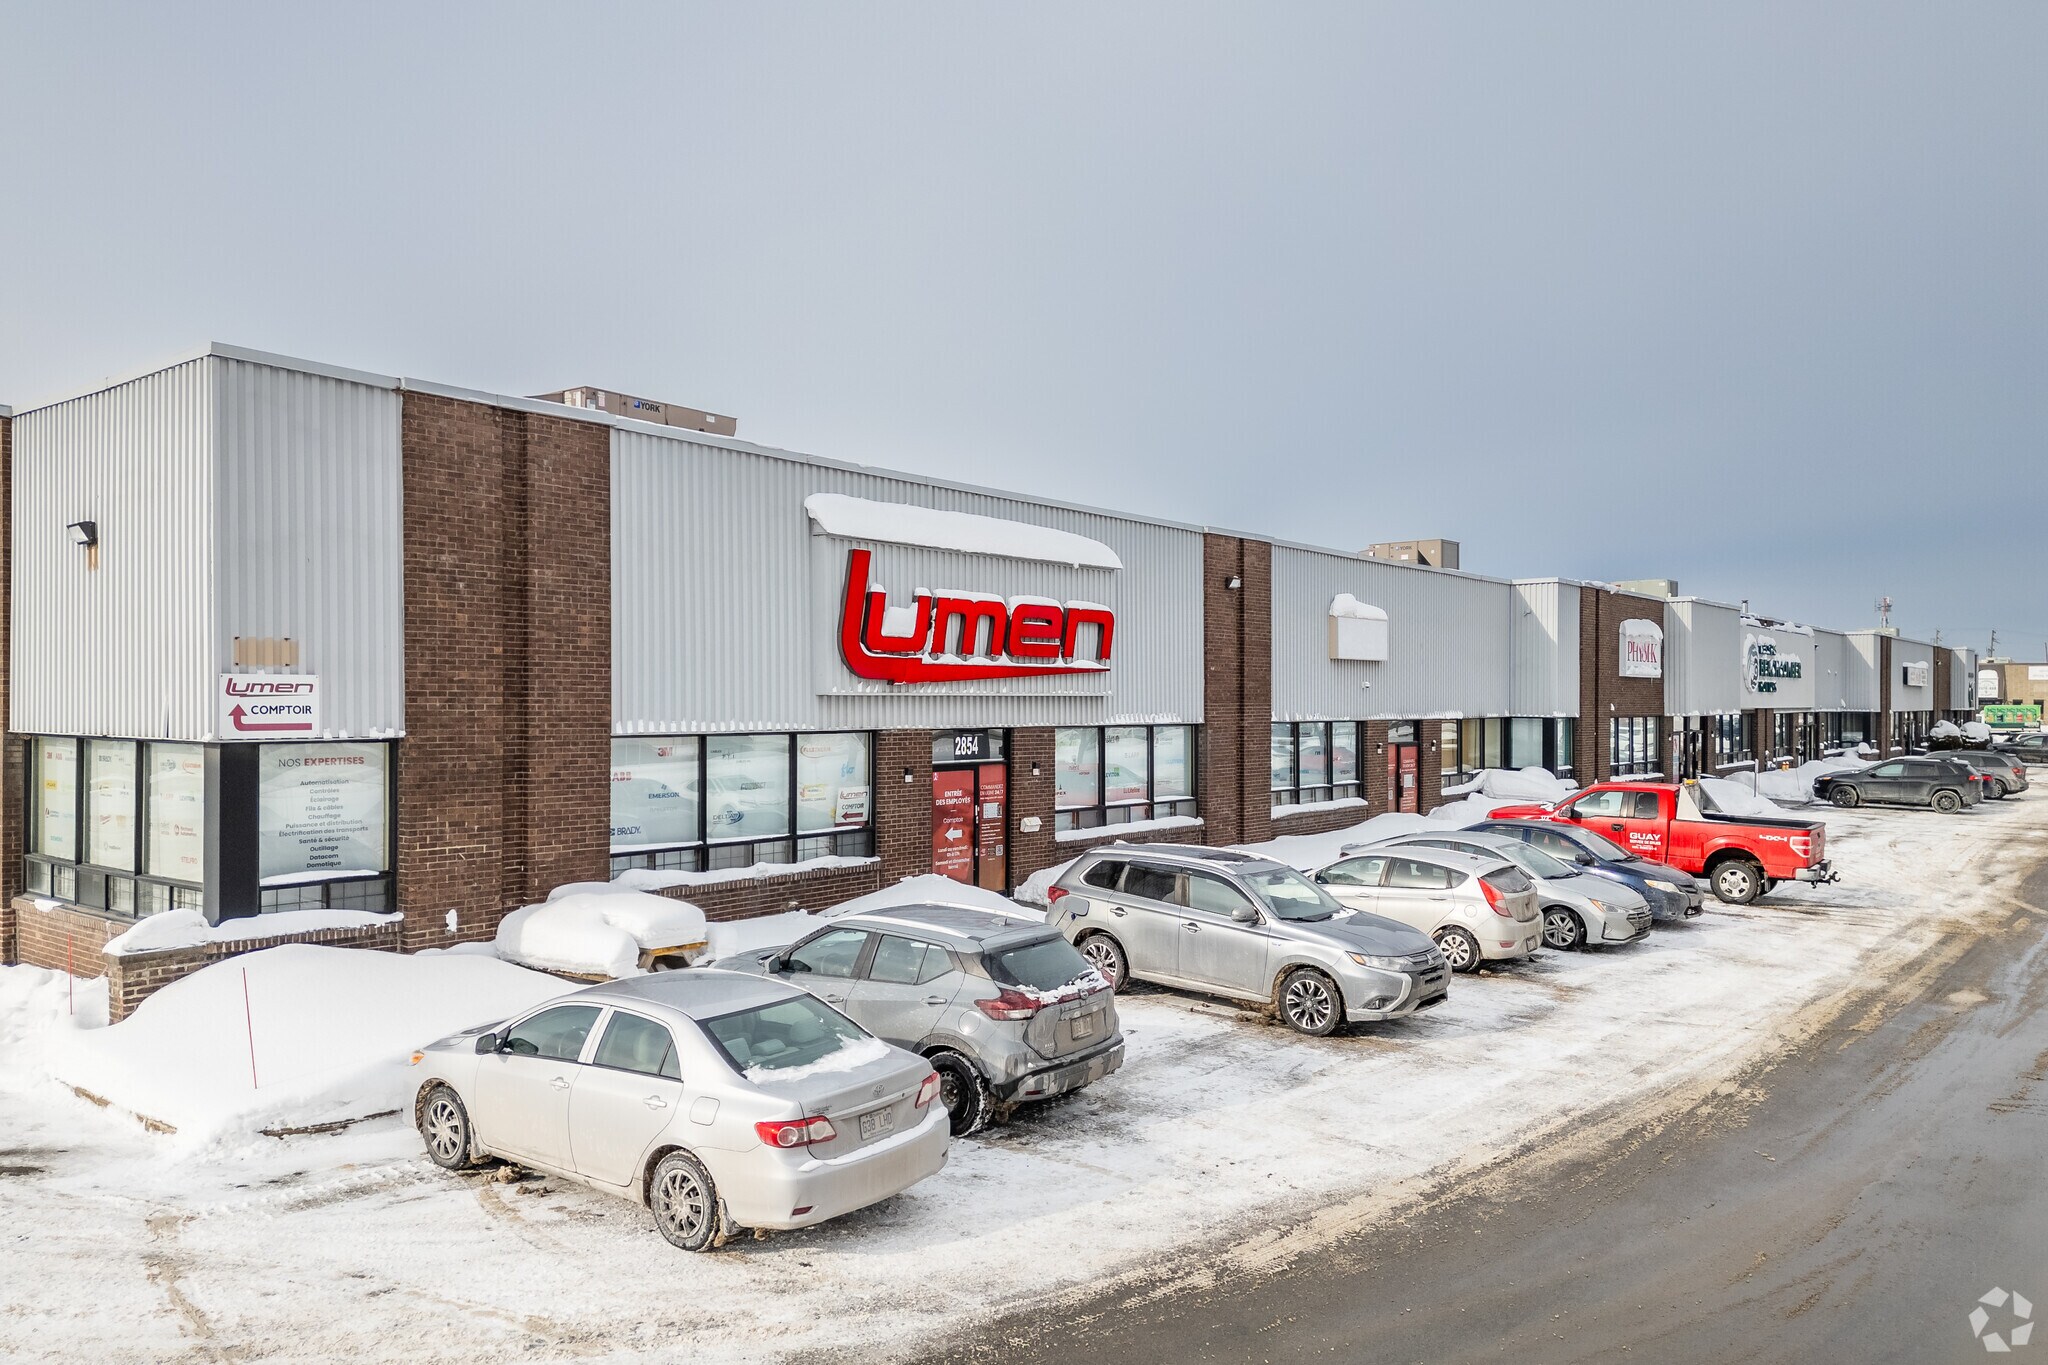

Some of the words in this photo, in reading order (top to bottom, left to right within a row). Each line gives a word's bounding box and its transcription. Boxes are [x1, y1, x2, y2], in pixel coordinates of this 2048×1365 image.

[640, 401, 661, 413] YORK
[250, 705, 312, 715] COMPTOIR
[955, 736, 978, 755] 2854
[657, 747, 673, 757] 3M
[278, 758, 301, 767] NOS
[304, 756, 365, 766] EXPERTISES
[612, 771, 632, 782] ABB
[648, 791, 680, 799] EMERSON
[944, 789, 963, 798] ENTRÉE
[946, 796, 971, 805] EMPLOYÉS
[326, 819, 363, 827] distribution
[278, 828, 323, 837] Électrification
[336, 825, 369, 833] transports
[1629, 832, 1661, 840] GUAY
[306, 860, 342, 868] Domotique
[862, 1118, 876, 1133] G38
